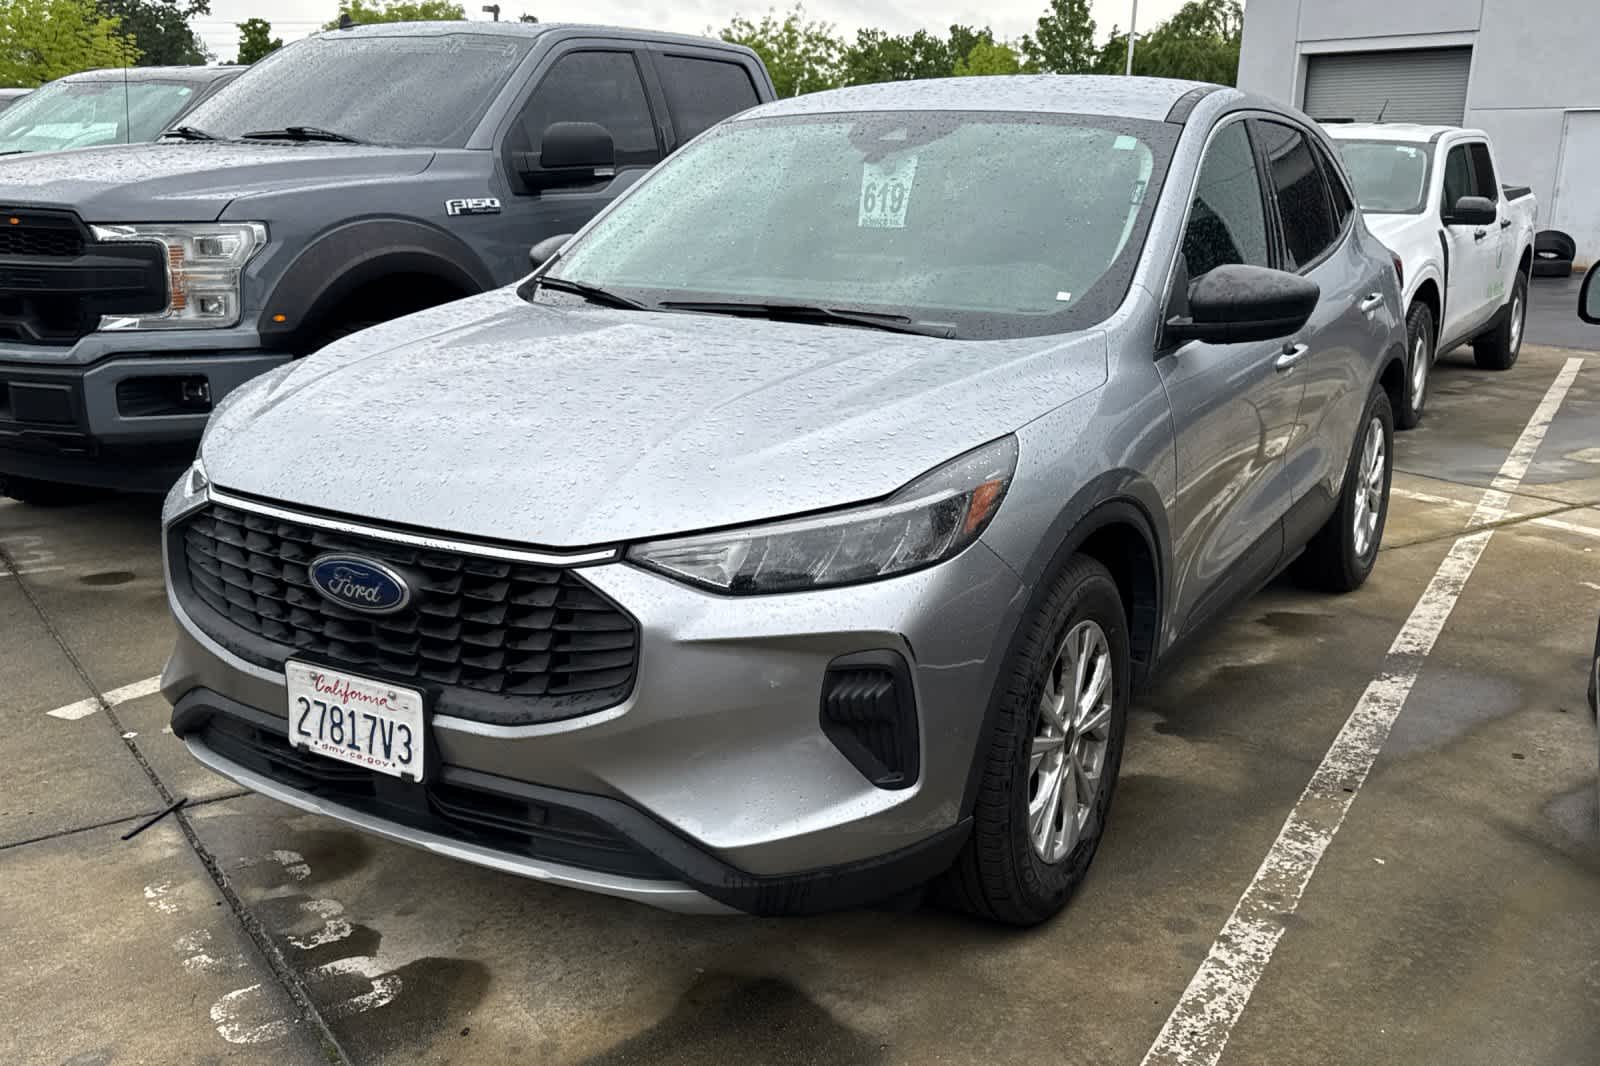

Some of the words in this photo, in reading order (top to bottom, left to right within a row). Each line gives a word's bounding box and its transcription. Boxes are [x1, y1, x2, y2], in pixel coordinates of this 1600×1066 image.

[863, 182, 905, 213] 619
[328, 566, 383, 603] Ford
[315, 674, 400, 711] California
[297, 697, 412, 765] 27817V3
[322, 743, 390, 768] dmv.ca.gov
